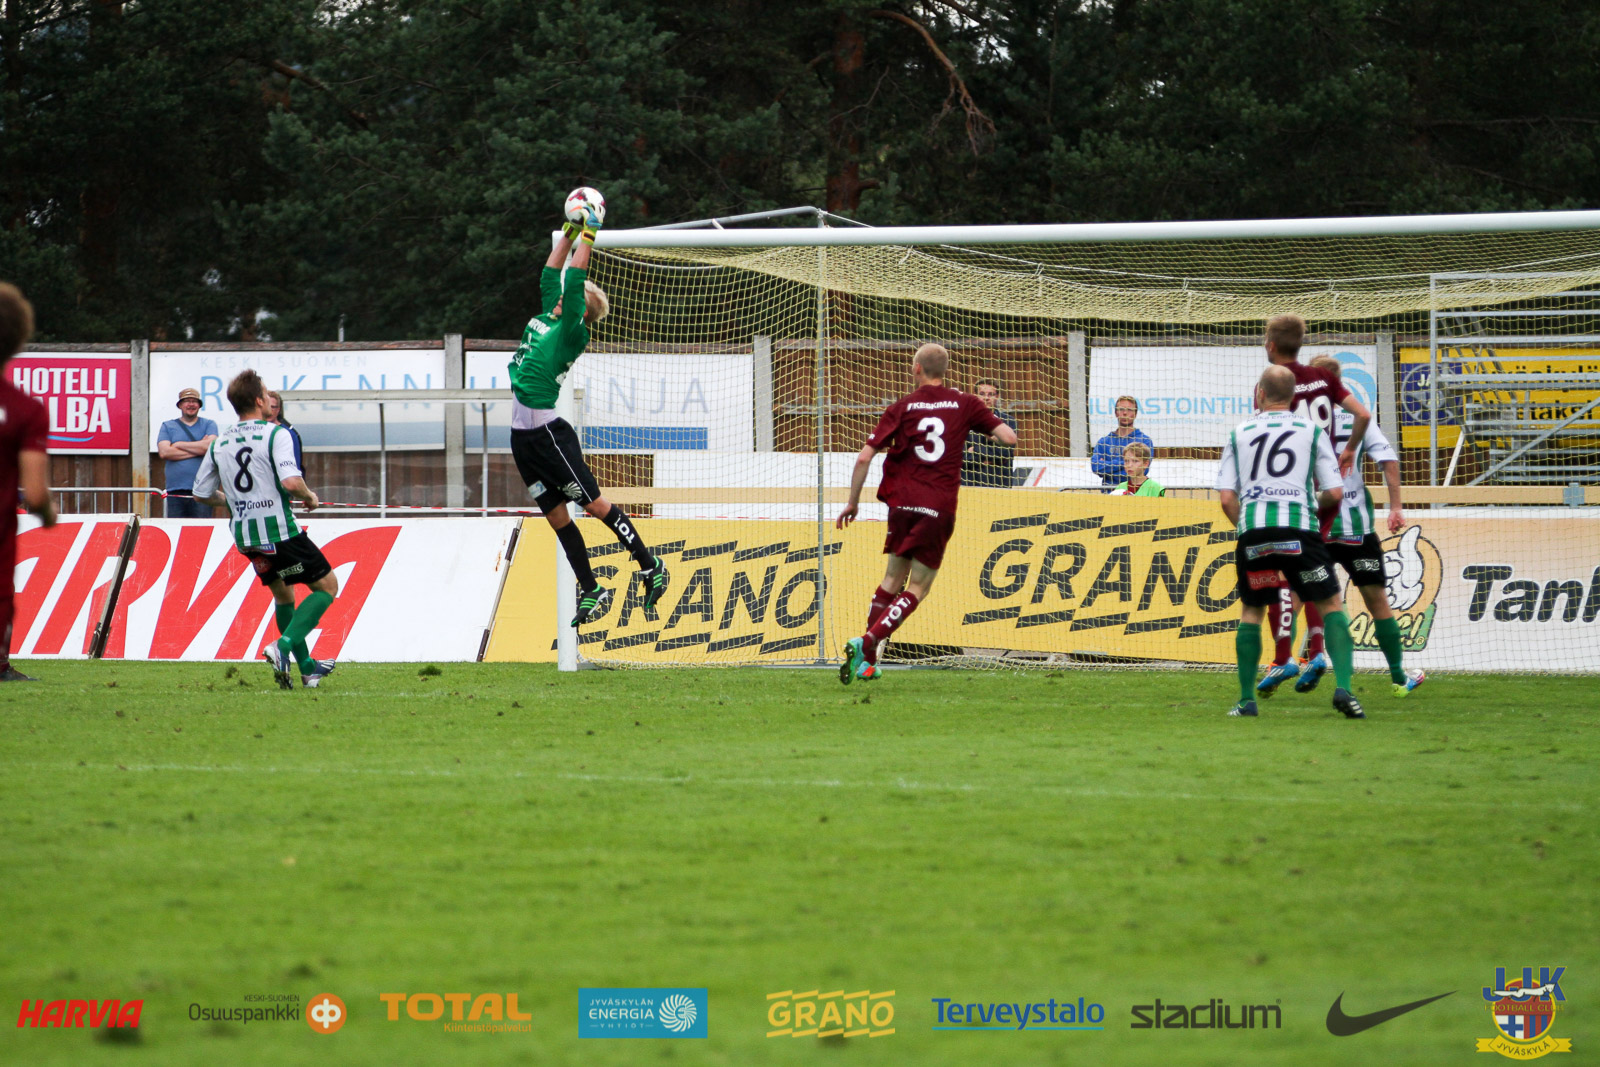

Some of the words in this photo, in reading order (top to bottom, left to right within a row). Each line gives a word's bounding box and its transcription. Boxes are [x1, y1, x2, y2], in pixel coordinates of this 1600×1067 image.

[200, 356, 368, 369] KESKI-SUOMEN
[13, 367, 117, 399] HOTELLI
[33, 396, 111, 432] LBA
[914, 417, 946, 462] 3
[1249, 430, 1297, 481] 16
[234, 446, 253, 493] 8
[247, 500, 274, 510] Group
[1265, 487, 1300, 498] Group
[979, 538, 1240, 613] GRANO
